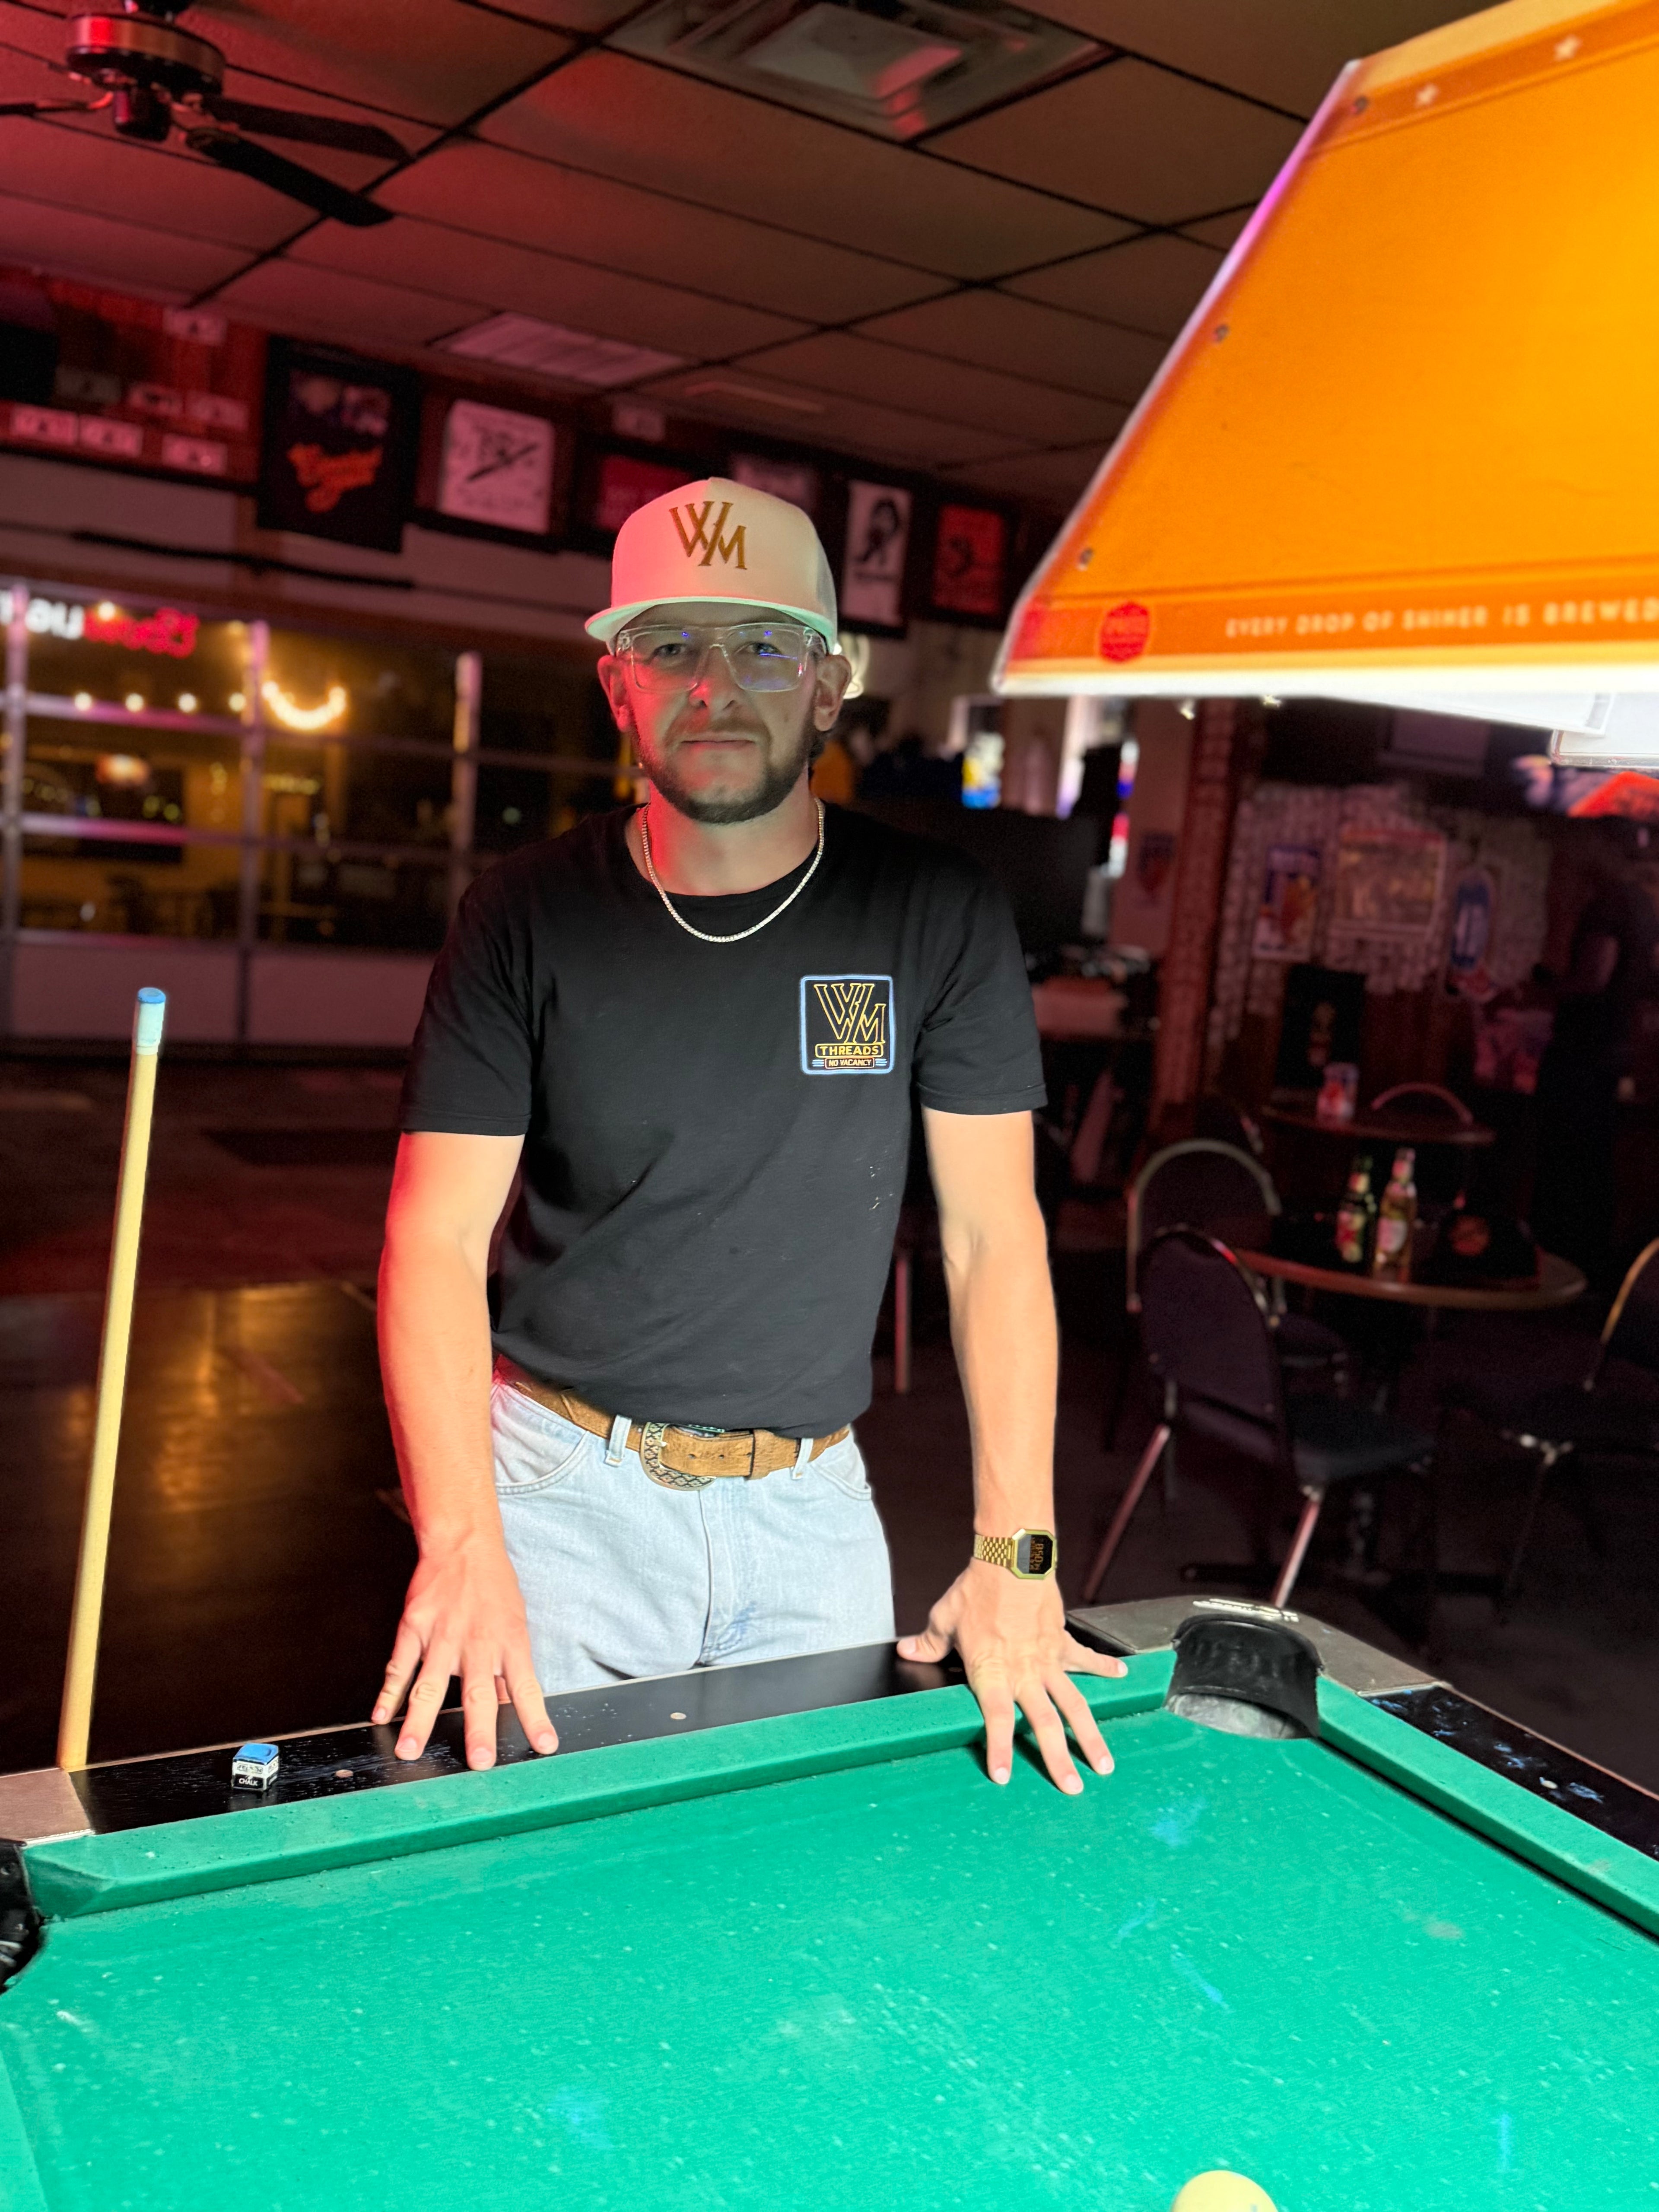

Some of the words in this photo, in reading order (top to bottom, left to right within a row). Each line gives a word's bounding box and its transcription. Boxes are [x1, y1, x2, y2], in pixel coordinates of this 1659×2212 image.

[1225, 615, 1288, 638] EVERY
[1297, 611, 1355, 636] DROP
[1362, 610, 1394, 632] OF
[1503, 603, 1530, 627] IS
[1543, 597, 1659, 626] BREWED
[814, 983, 886, 1044] WM
[819, 1046, 879, 1055] THREADS
[238, 1778, 258, 1786] CHALK
